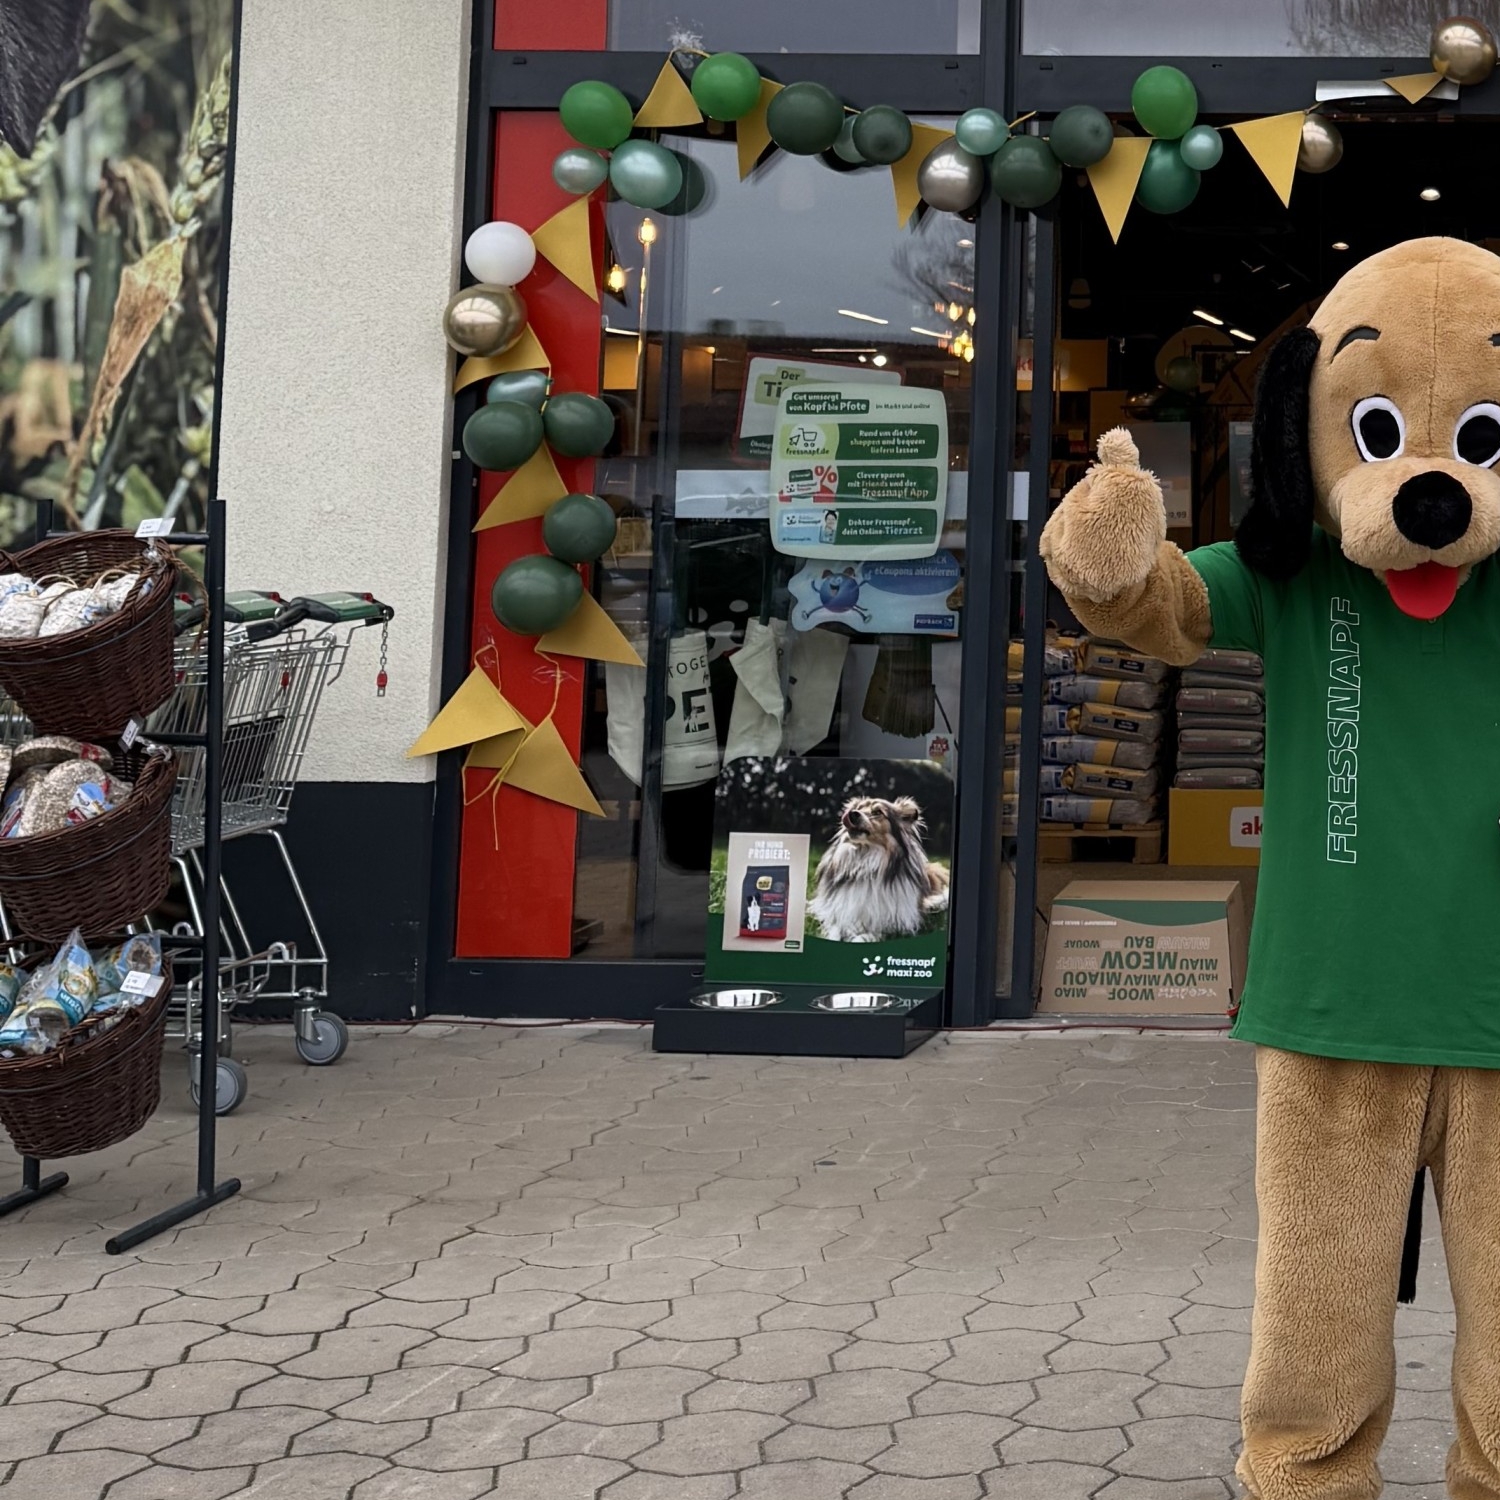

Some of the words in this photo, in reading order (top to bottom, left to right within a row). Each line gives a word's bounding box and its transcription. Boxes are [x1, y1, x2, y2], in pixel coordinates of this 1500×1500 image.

[781, 370, 801, 382] Der
[793, 393, 807, 402] Gut
[808, 394, 839, 403] umsorgt
[789, 404, 803, 412] von
[803, 401, 828, 414] Kopf
[840, 400, 867, 412] Pfote
[859, 429, 878, 437] Rund
[892, 429, 903, 437] die
[904, 429, 918, 437] Uhr
[850, 437, 880, 447] shoppen
[881, 437, 895, 445] und
[896, 437, 926, 447] bequem
[785, 447, 830, 457] fressnapf.de
[896, 446, 919, 454] lassen
[856, 471, 879, 479] Clever
[880, 471, 905, 481] sparen
[847, 480, 860, 488] mit
[861, 480, 888, 488] Friends
[889, 480, 903, 488] und
[904, 480, 917, 488] der
[861, 488, 909, 498] Fressnapf
[909, 488, 929, 498] App
[848, 518, 874, 526] Doktor
[875, 517, 911, 527] Fressnapf
[842, 527, 858, 536] dein
[874, 566, 913, 577] eCoupons
[914, 567, 959, 577] aktivieren!
[1326, 596, 1362, 864] FRESSNAPF
[748, 848, 791, 860] PROBIERT:
[1064, 939, 1100, 949] WOUAF
[1123, 935, 1155, 949] BAU
[886, 955, 936, 969] fressnapf
[1100, 950, 1178, 970] MEOW
[1179, 958, 1218, 971] MIAU
[886, 968, 912, 978] maxi
[913, 969, 933, 978] zoo
[1062, 971, 1122, 986] MIAOU
[1198, 973, 1218, 982] HAU
[1123, 973, 1161, 986] MIAV
[1162, 972, 1197, 987] VOV
[1054, 987, 1087, 998] MIAO
[1107, 987, 1155, 1001] WOOF
